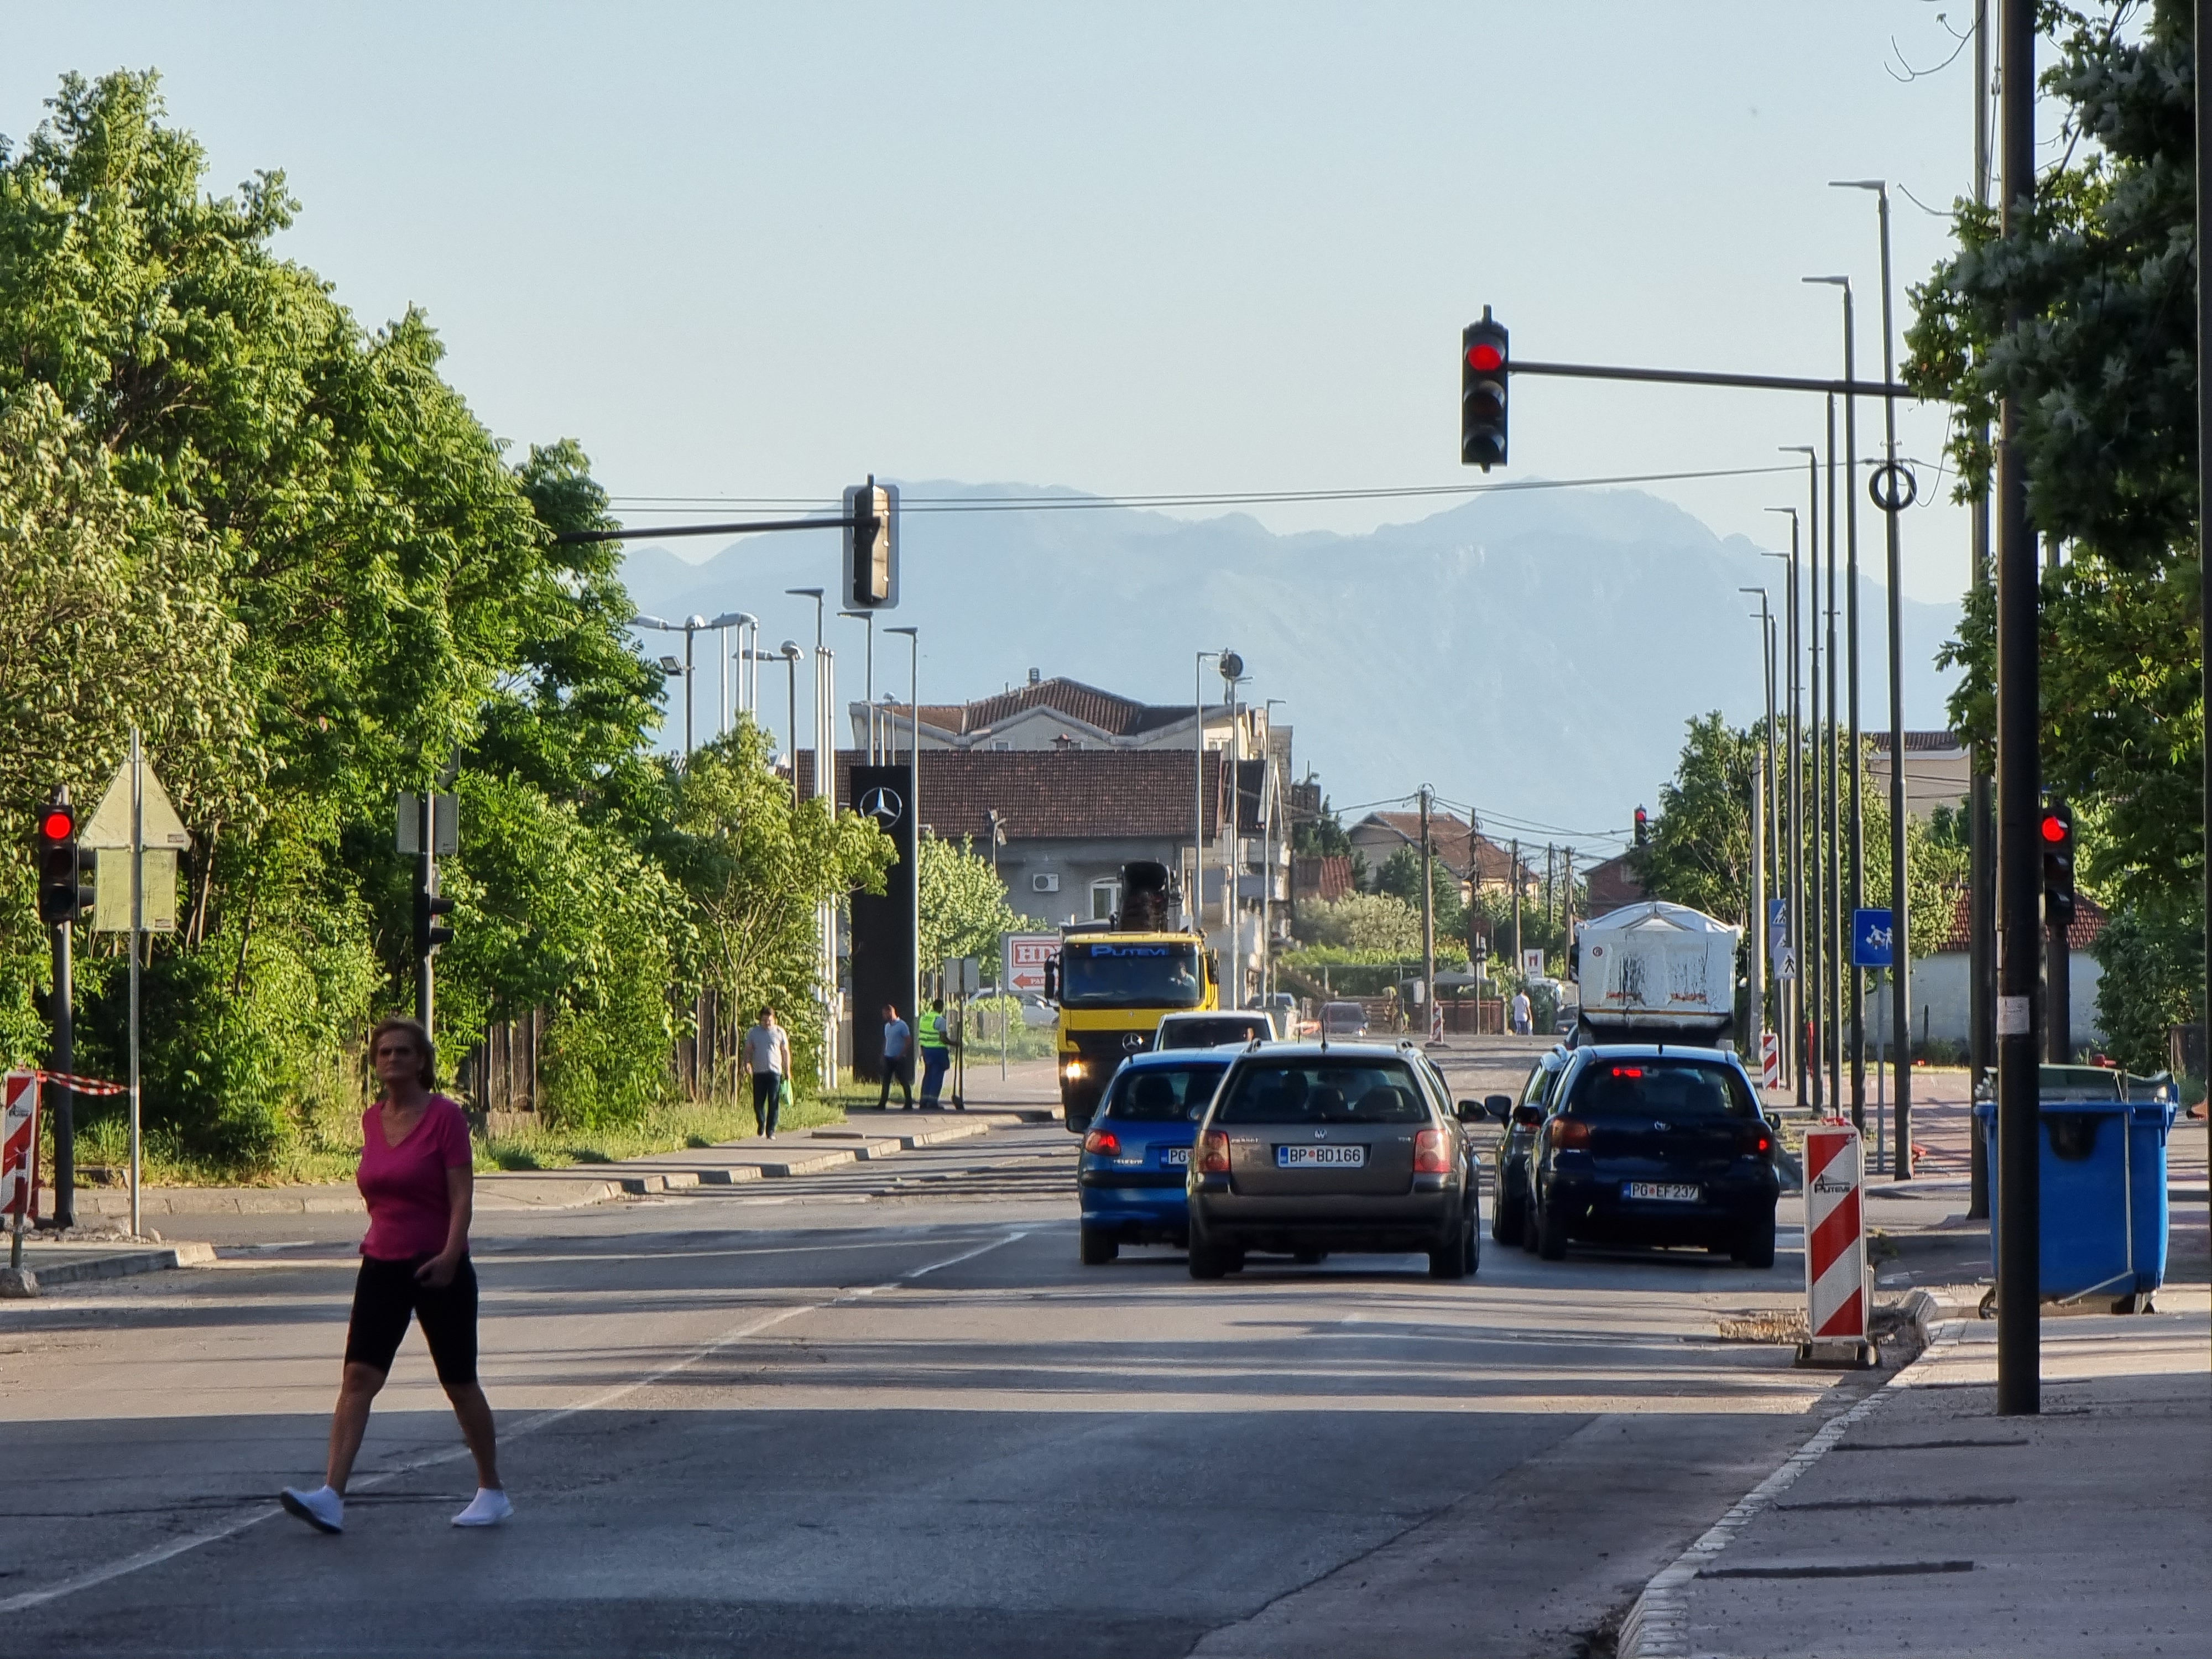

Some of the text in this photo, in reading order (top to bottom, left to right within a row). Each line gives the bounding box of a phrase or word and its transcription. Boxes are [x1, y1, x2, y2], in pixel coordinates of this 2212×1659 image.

[1016, 946, 1060, 962] HD
[1170, 1150, 1187, 1162] PG
[1290, 1149, 1360, 1162] BP BD166
[1632, 1183, 1698, 1198] PG EF237
